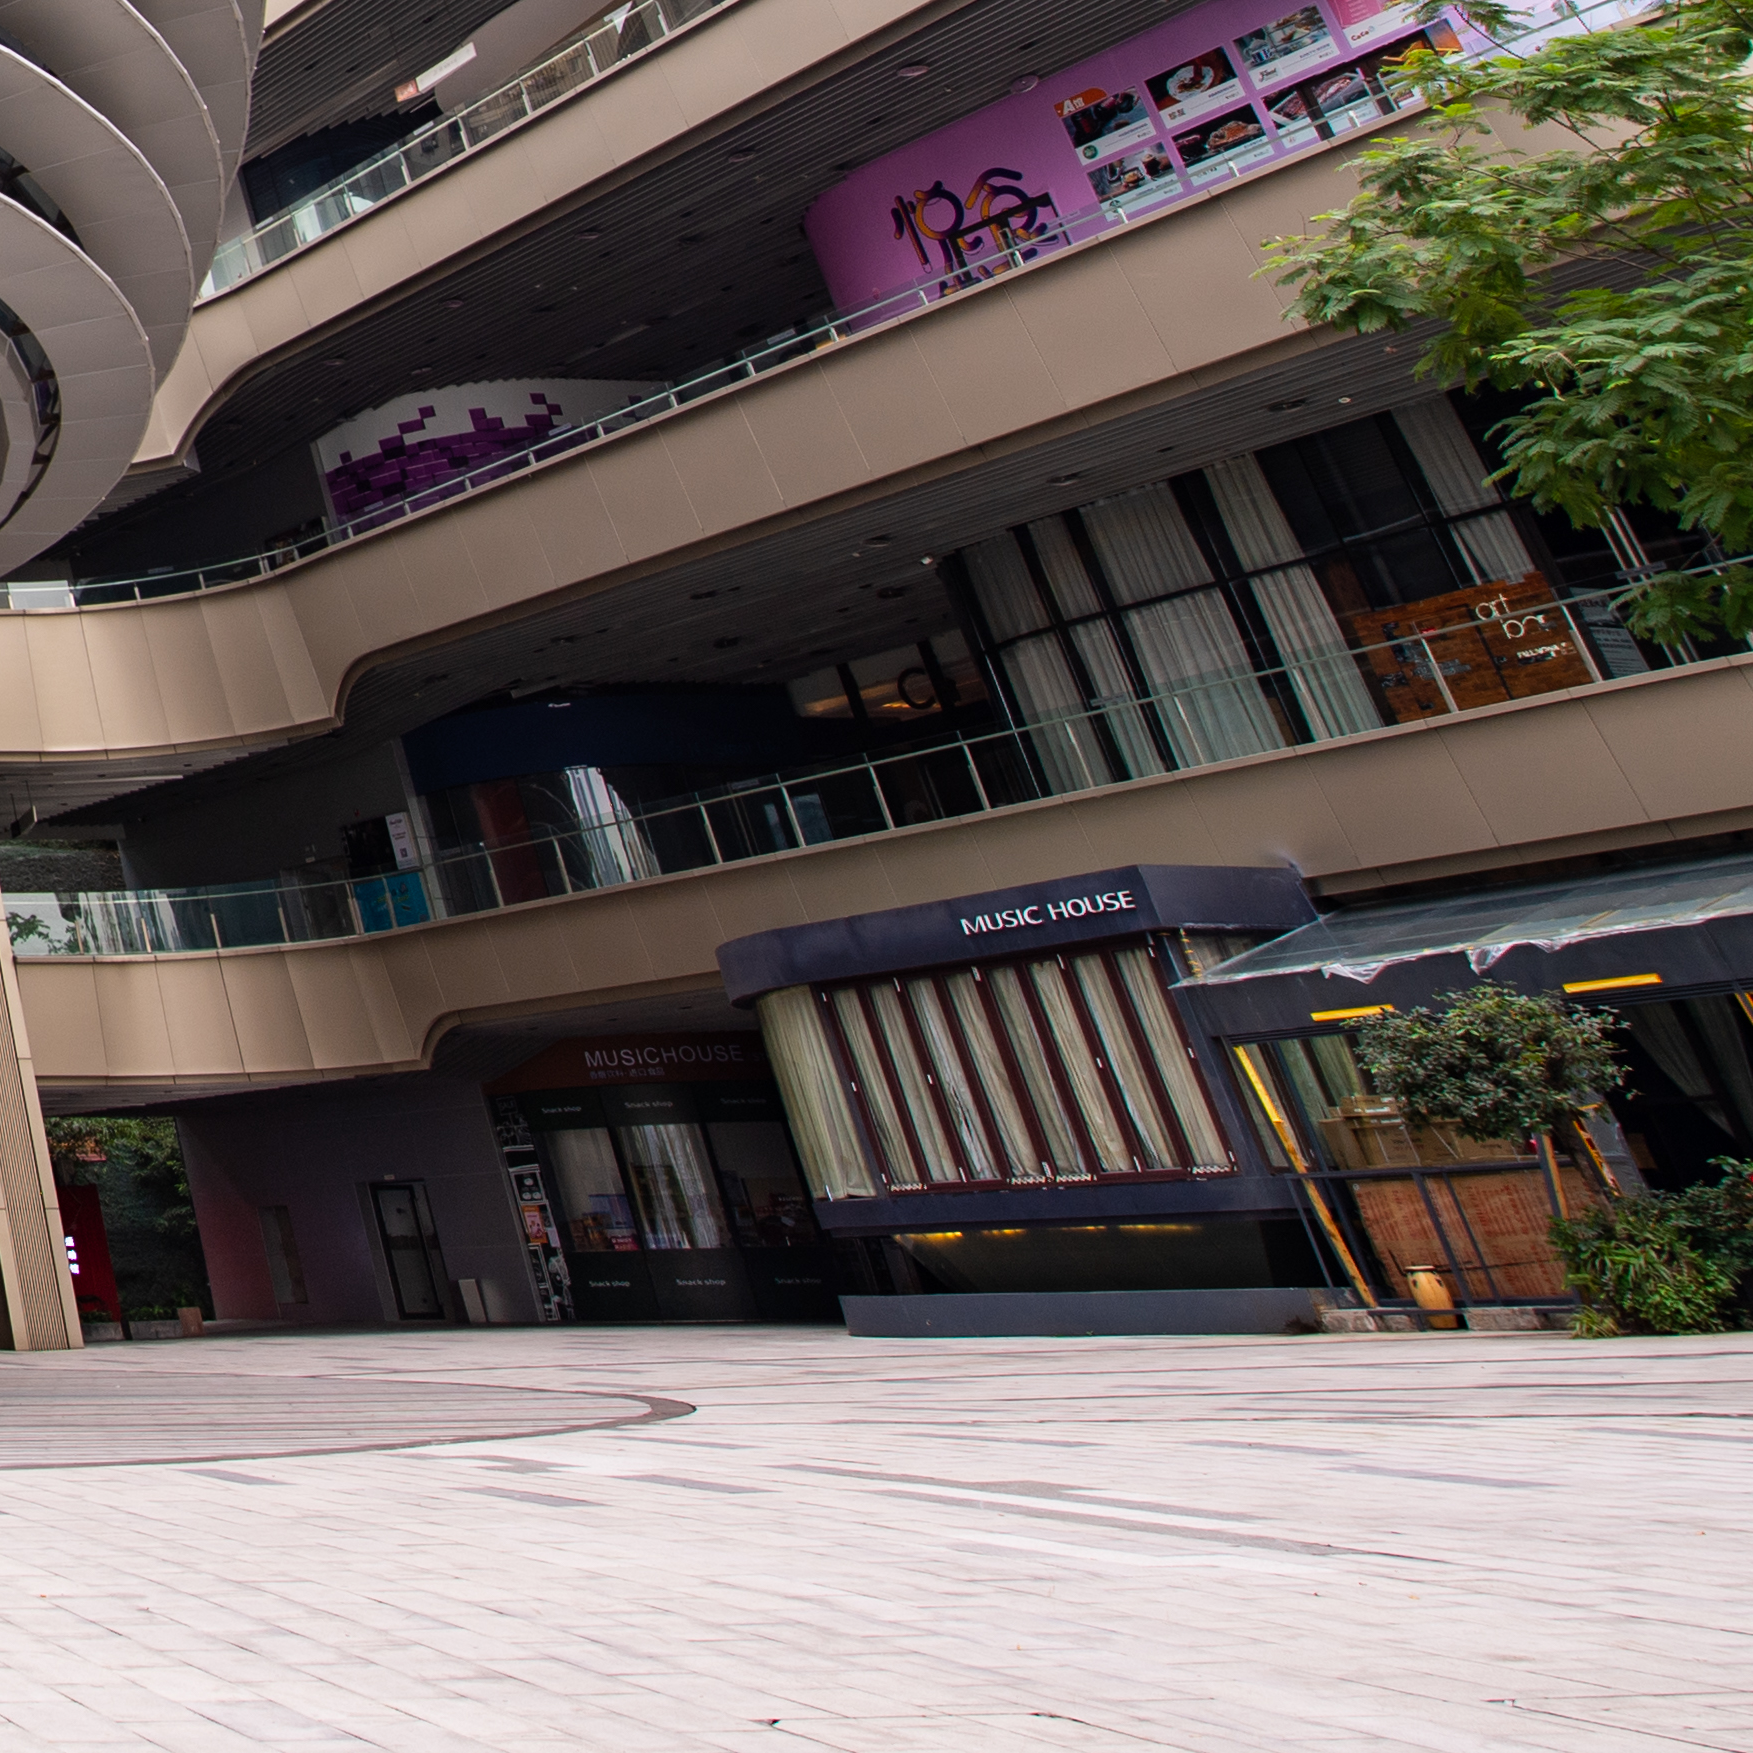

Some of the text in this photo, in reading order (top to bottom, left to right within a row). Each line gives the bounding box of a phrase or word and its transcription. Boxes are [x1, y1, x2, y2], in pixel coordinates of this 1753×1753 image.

[960, 890, 1136, 936] MUSIC HOUSE
[584, 1045, 745, 1068] MUSICHOUSE
